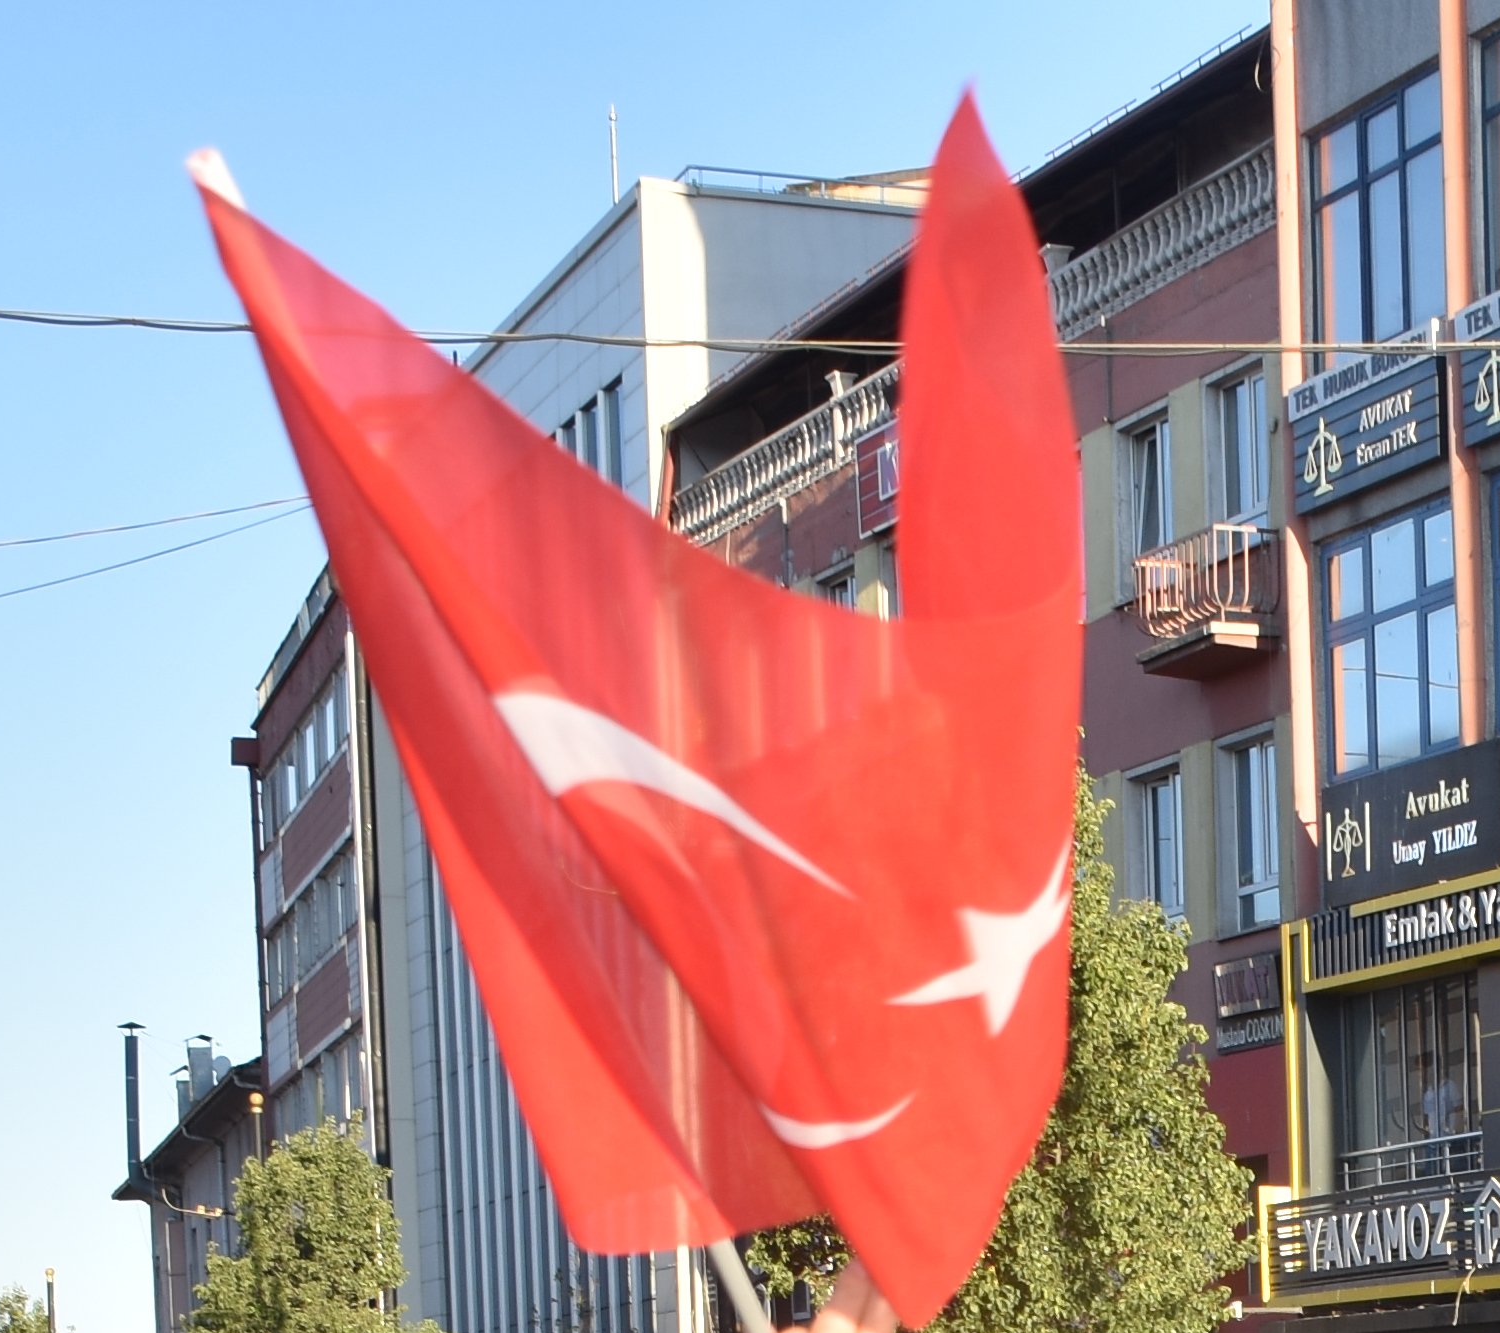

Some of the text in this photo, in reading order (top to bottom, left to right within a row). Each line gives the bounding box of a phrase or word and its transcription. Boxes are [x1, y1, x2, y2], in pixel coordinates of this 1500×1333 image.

[1465, 310, 1493, 335] TEK
[1294, 385, 1318, 413] TEK
[1324, 362, 1369, 400] HUKUK
[1359, 390, 1413, 432] AVUKAT
[1391, 421, 1417, 452] TEK
[1406, 778, 1469, 819] Avukat
[1432, 821, 1478, 856] YILDIZ
[1386, 903, 1454, 948] Emlak
[1459, 896, 1477, 930] &
[1305, 1198, 1451, 1273] YAKAMOZ
